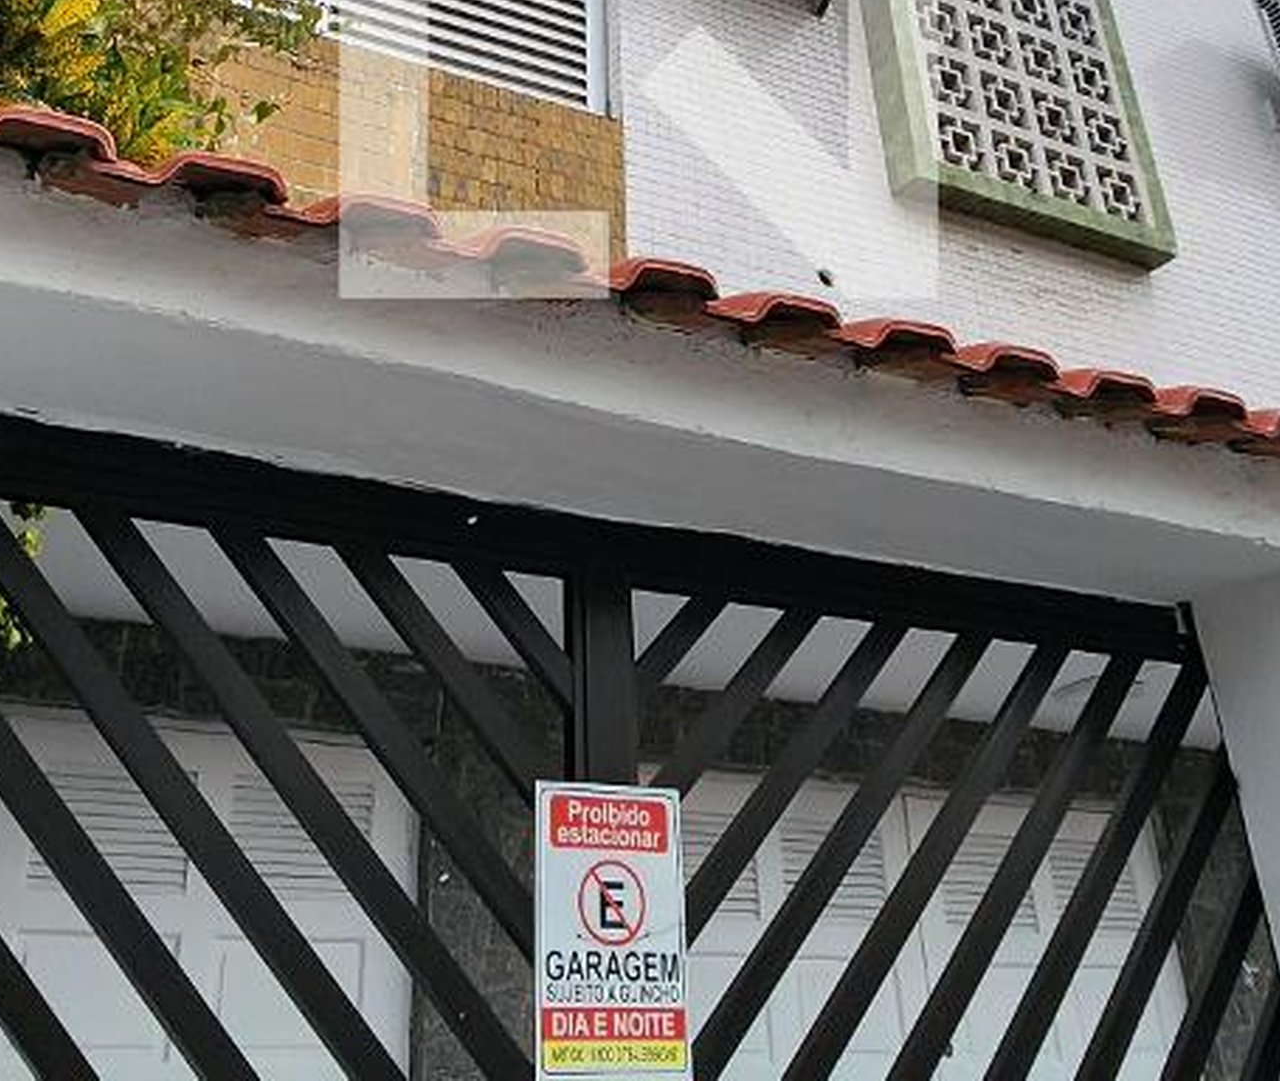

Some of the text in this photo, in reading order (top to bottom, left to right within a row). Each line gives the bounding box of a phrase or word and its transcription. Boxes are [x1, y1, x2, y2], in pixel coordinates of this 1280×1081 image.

[567, 800, 651, 825] Proibido
[557, 826, 661, 849] estacionar
[599, 880, 625, 930] E
[545, 950, 681, 983] GARAGEM
[551, 1011, 676, 1037] DIA E NOITE
